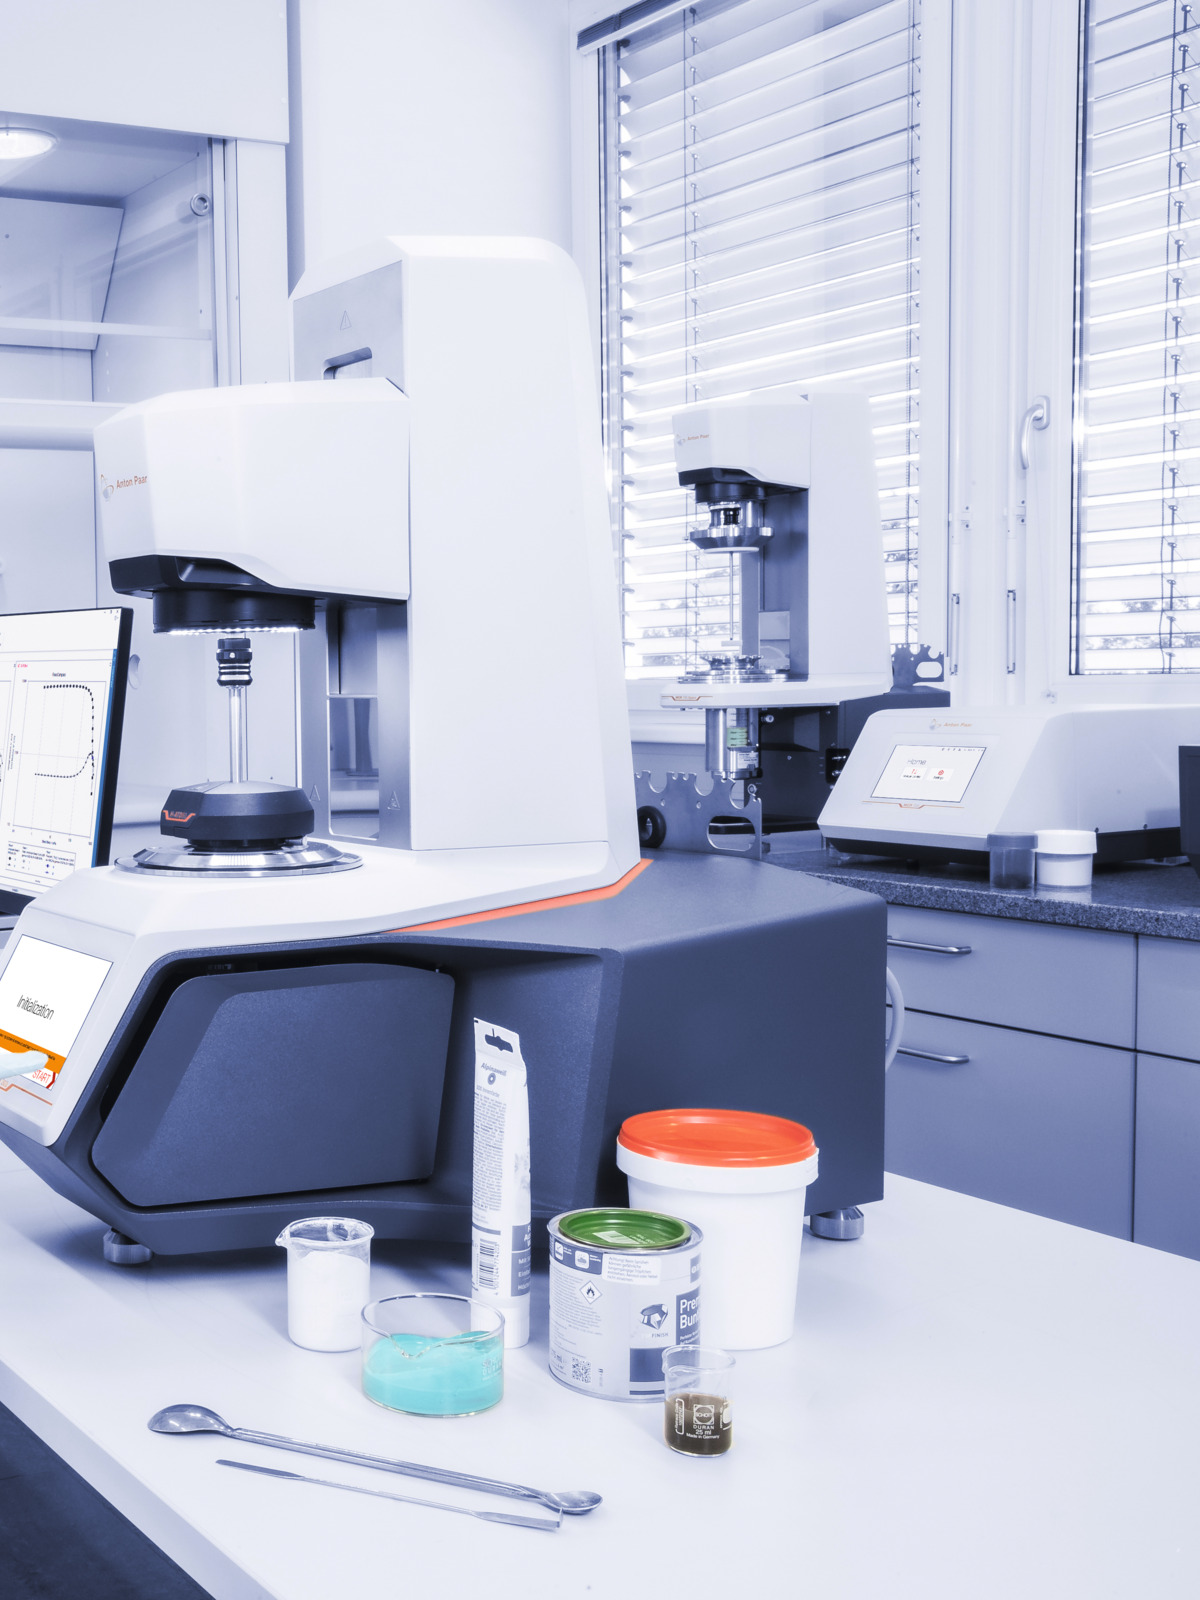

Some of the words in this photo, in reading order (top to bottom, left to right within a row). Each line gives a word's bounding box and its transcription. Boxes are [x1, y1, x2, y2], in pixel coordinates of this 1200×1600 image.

[116, 478, 133, 488] Anton
[134, 475, 148, 485] Paar
[17, 994, 54, 1020] Initialization
[32, 1070, 51, 1083] START
